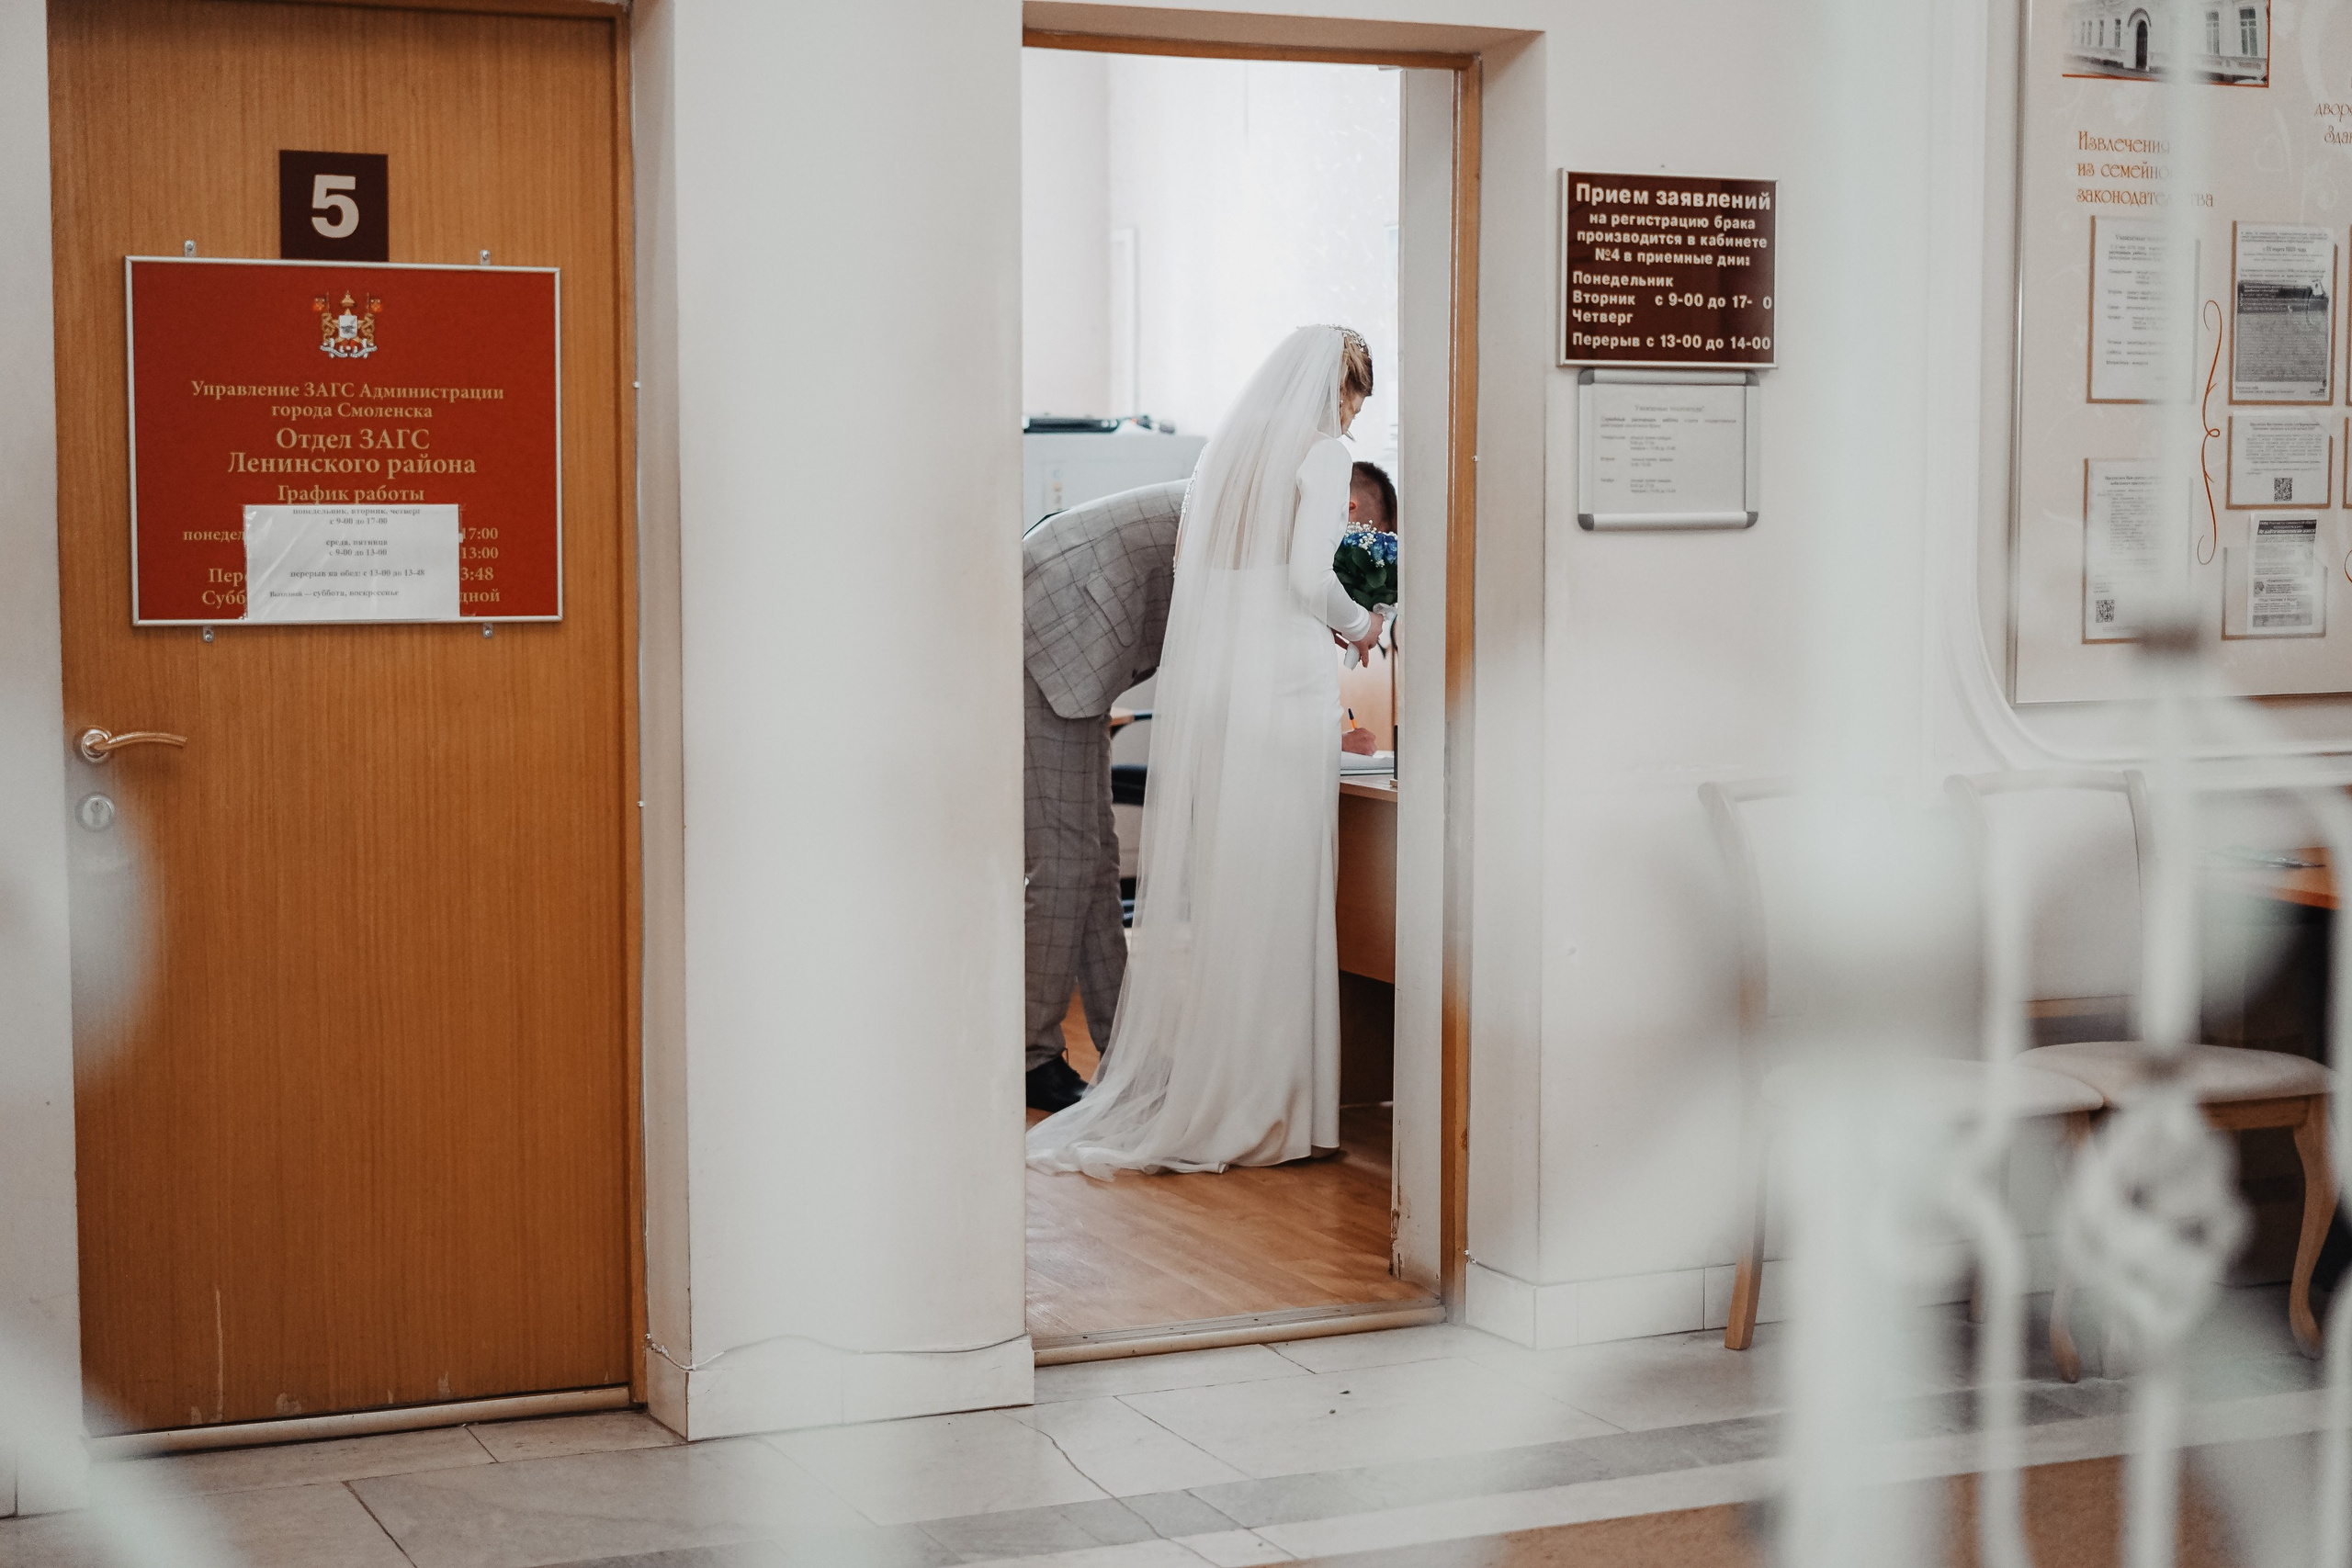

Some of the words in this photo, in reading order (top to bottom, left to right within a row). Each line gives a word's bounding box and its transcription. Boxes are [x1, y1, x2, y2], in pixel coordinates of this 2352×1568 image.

[2077, 163, 2095, 176] из
[1576, 183, 1649, 206] Прием
[1657, 190, 1771, 210] заявлений
[311, 174, 360, 239] 5
[1589, 213, 1607, 224] на
[1611, 214, 1709, 229] регистрацию
[1714, 215, 1756, 231] брака
[1577, 231, 1682, 246] производится
[1687, 236, 1696, 245] в
[1701, 232, 1768, 248] кабинете
[1595, 248, 1620, 262] №4
[1623, 252, 1632, 262] в
[1637, 253, 1713, 265] приемные
[1717, 255, 1750, 266] дни:
[1572, 271, 1674, 288] Понедельник
[1572, 289, 1635, 307] Вторник
[1655, 295, 1664, 306] с
[1668, 292, 1704, 307] 9-00
[1707, 297, 1726, 310] до
[1572, 309, 1634, 326] Четверг
[1572, 332, 1641, 349] Перерыв
[1645, 337, 1655, 347] с
[1660, 334, 1702, 348] 13-00
[1705, 338, 1724, 351] до
[1730, 336, 1771, 350] 14-00
[191, 380, 300, 400] Управление
[304, 382, 356, 398] ЗАГС
[359, 383, 504, 402] Администрации
[272, 404, 333, 421] города
[337, 402, 433, 418] Смоленска
[277, 427, 352, 453] Отдел
[359, 428, 431, 450] ЗАГС
[228, 452, 380, 474] Ленинского
[388, 454, 477, 479] района
[277, 484, 349, 504] График
[354, 485, 425, 504] работы
[184, 531, 244, 542] понедел
[461, 547, 499, 559] 13:00
[209, 569, 246, 587] Пер
[460, 567, 494, 581] 3:48
[202, 590, 246, 609] Субб
[460, 589, 501, 604] дной
